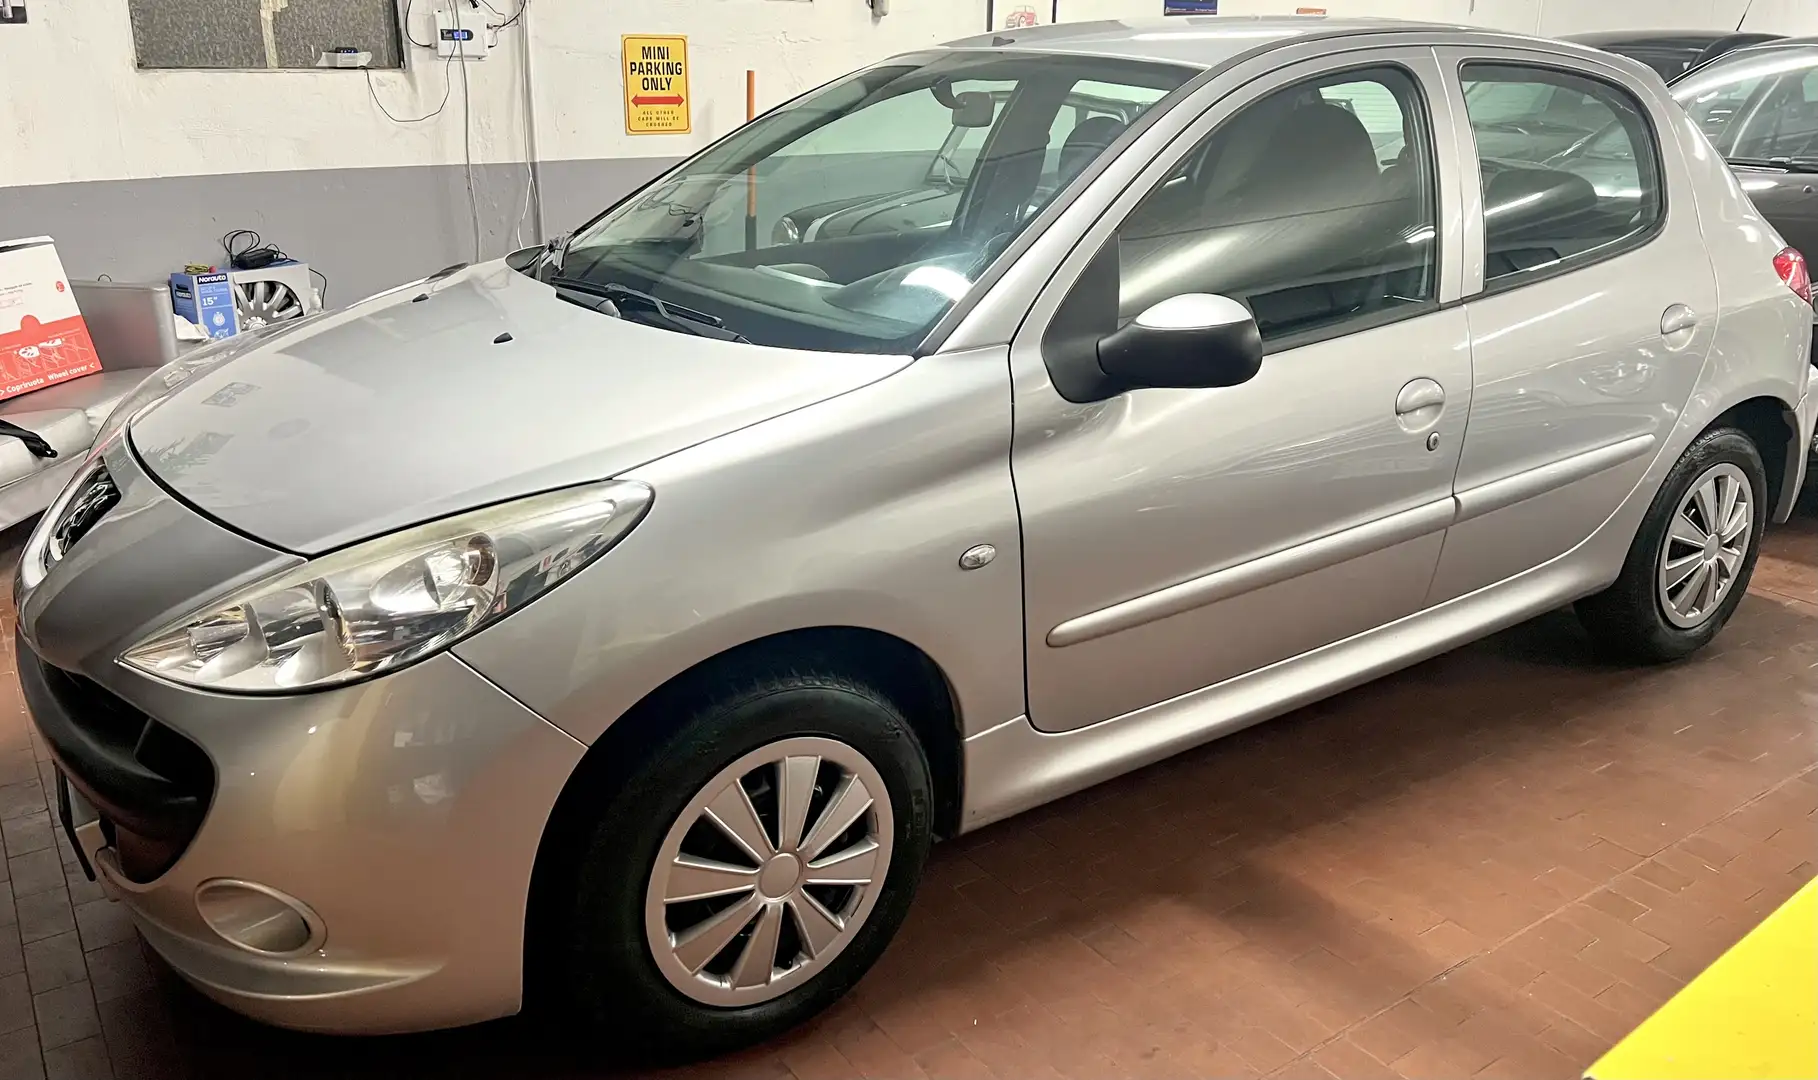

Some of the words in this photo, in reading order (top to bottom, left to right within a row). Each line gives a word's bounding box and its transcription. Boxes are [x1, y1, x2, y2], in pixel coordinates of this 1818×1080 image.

[641, 46, 670, 60] MINI
[630, 61, 683, 76] PARKING
[641, 77, 673, 91] ONLY
[198, 275, 226, 283] Norauto
[6, 378, 45, 393] Copriruota
[47, 370, 69, 381] Wheel
[69, 365, 88, 375] cover
